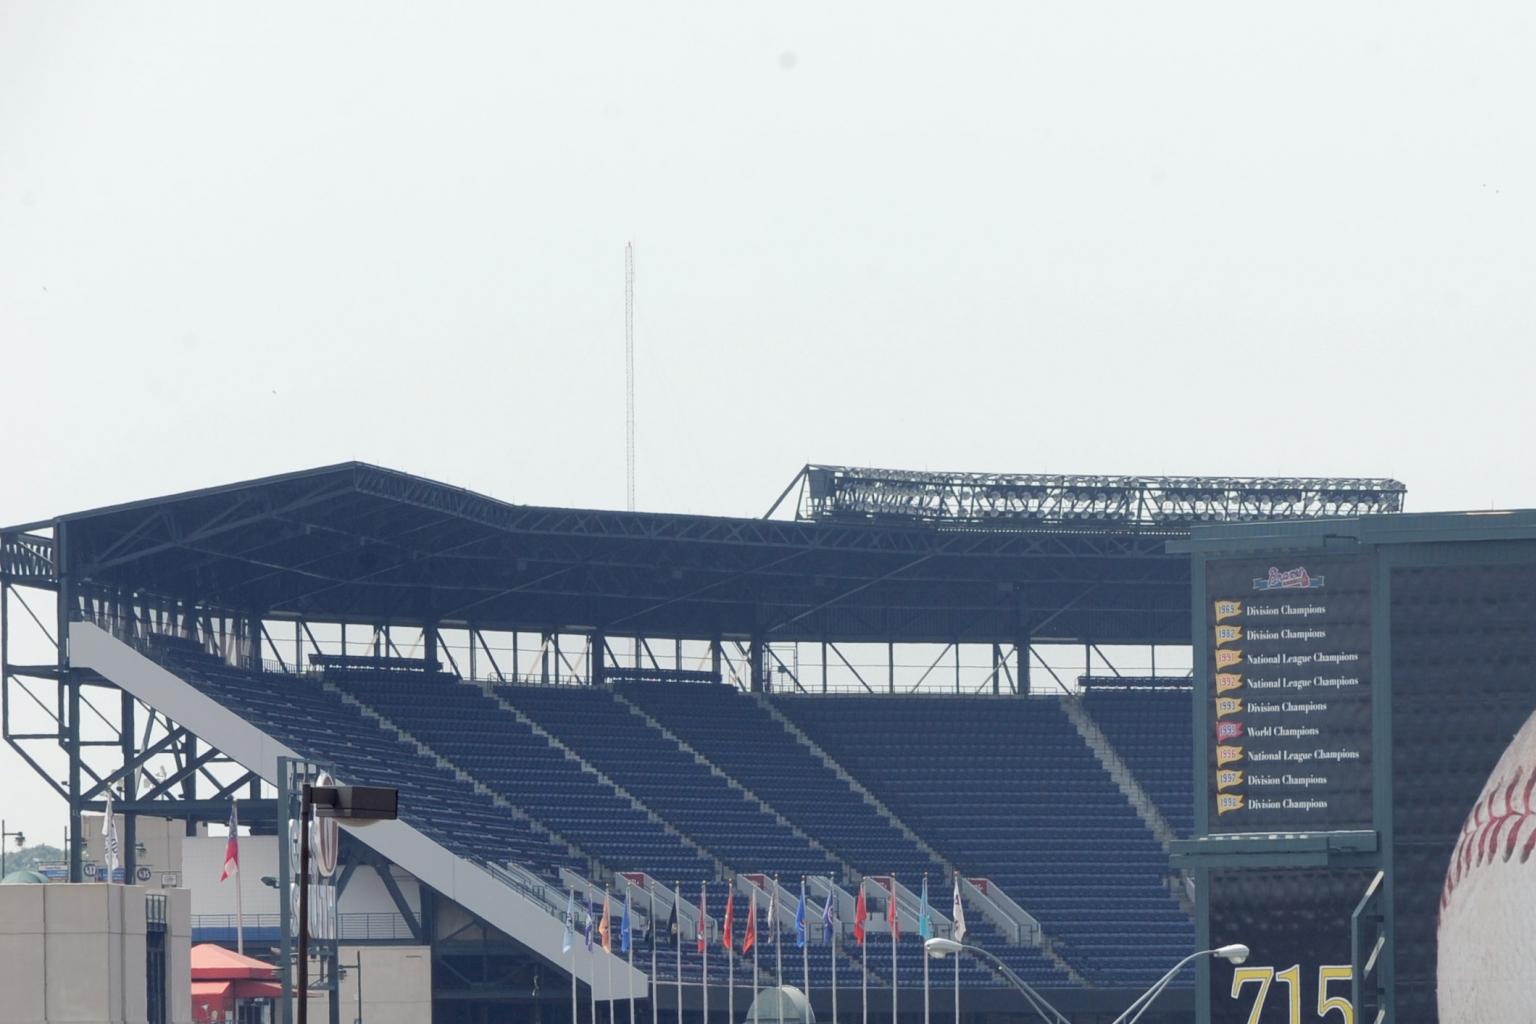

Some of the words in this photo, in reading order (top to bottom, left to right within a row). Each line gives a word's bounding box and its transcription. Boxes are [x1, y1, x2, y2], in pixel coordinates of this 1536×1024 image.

[1247, 606, 1279, 616] Division
[1281, 604, 1325, 617] Champions
[1247, 630, 1279, 640] Division
[1281, 628, 1326, 641] Champions
[1248, 654, 1280, 664] National
[1283, 654, 1312, 666] League
[1313, 652, 1358, 664] Champions
[1248, 678, 1280, 688] National
[1283, 678, 1312, 690] League
[1314, 676, 1358, 688] Champions
[1248, 703, 1280, 712] Division
[1282, 701, 1327, 714] Champions
[1248, 727, 1271, 736] World
[1274, 726, 1319, 739] Champions
[1248, 750, 1281, 761] National
[1284, 750, 1312, 762] League
[1314, 749, 1359, 761] Champions
[1248, 776, 1280, 785] Division
[1282, 775, 1327, 787] Champions
[1249, 800, 1280, 809] Division
[1283, 799, 1327, 811] Champions
